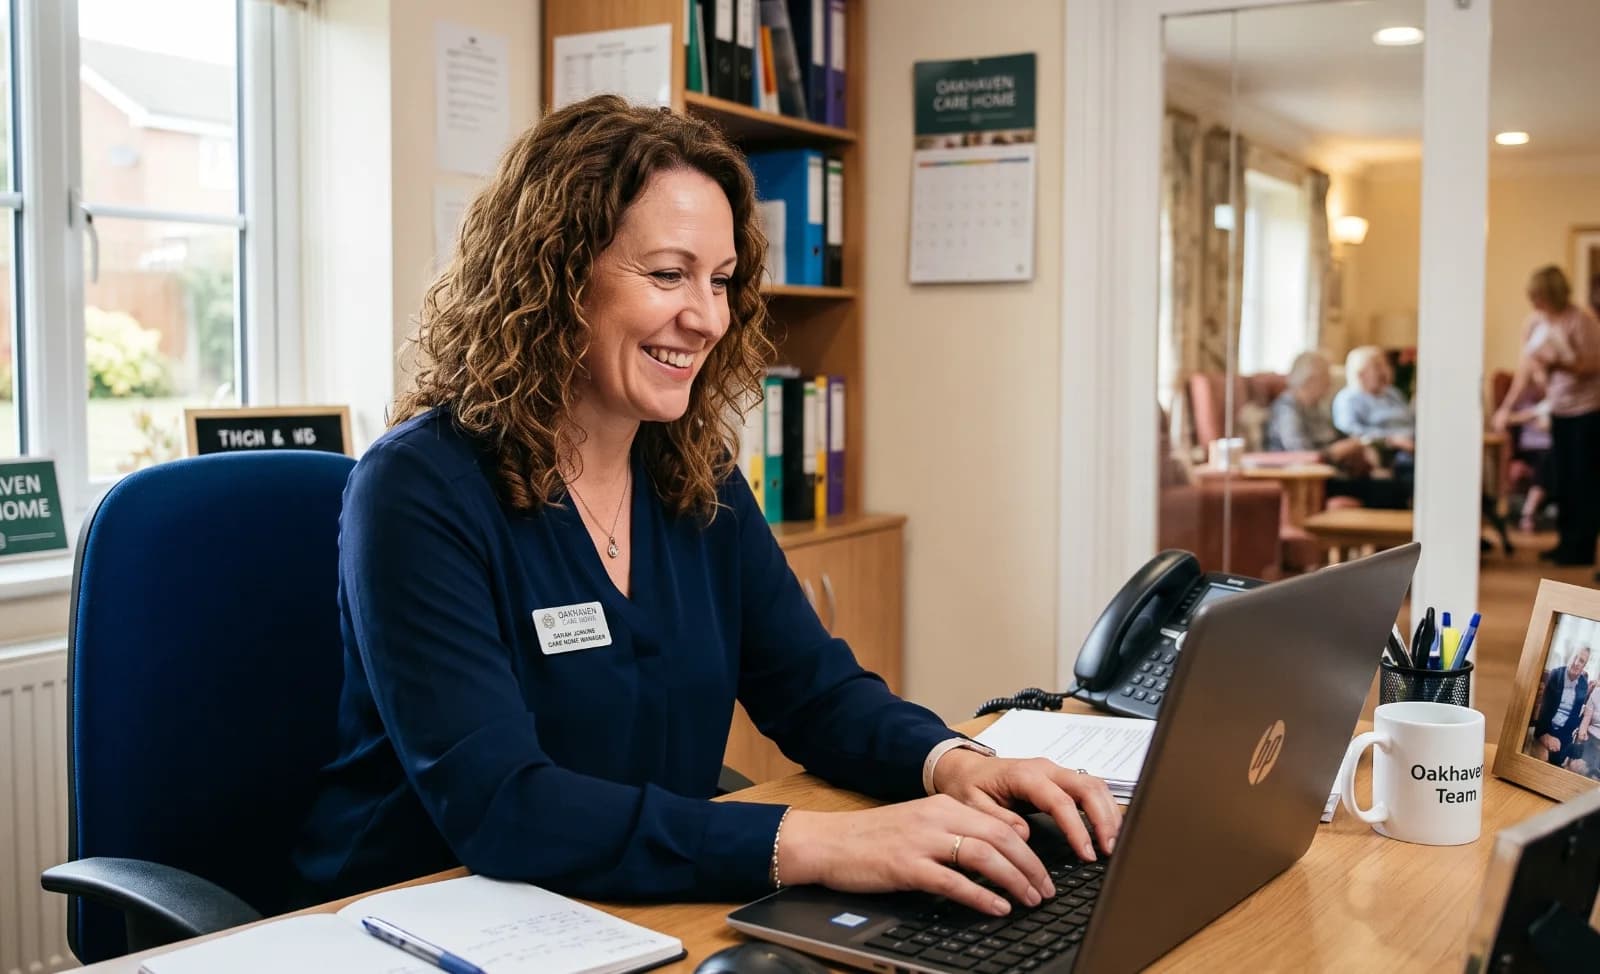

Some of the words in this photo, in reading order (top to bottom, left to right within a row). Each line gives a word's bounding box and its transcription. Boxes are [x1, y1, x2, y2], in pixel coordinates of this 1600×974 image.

[933, 95, 969, 112] CARE
[971, 91, 1016, 108] HOME
[1251, 719, 1282, 785] hp
[1435, 788, 1477, 804] Team
